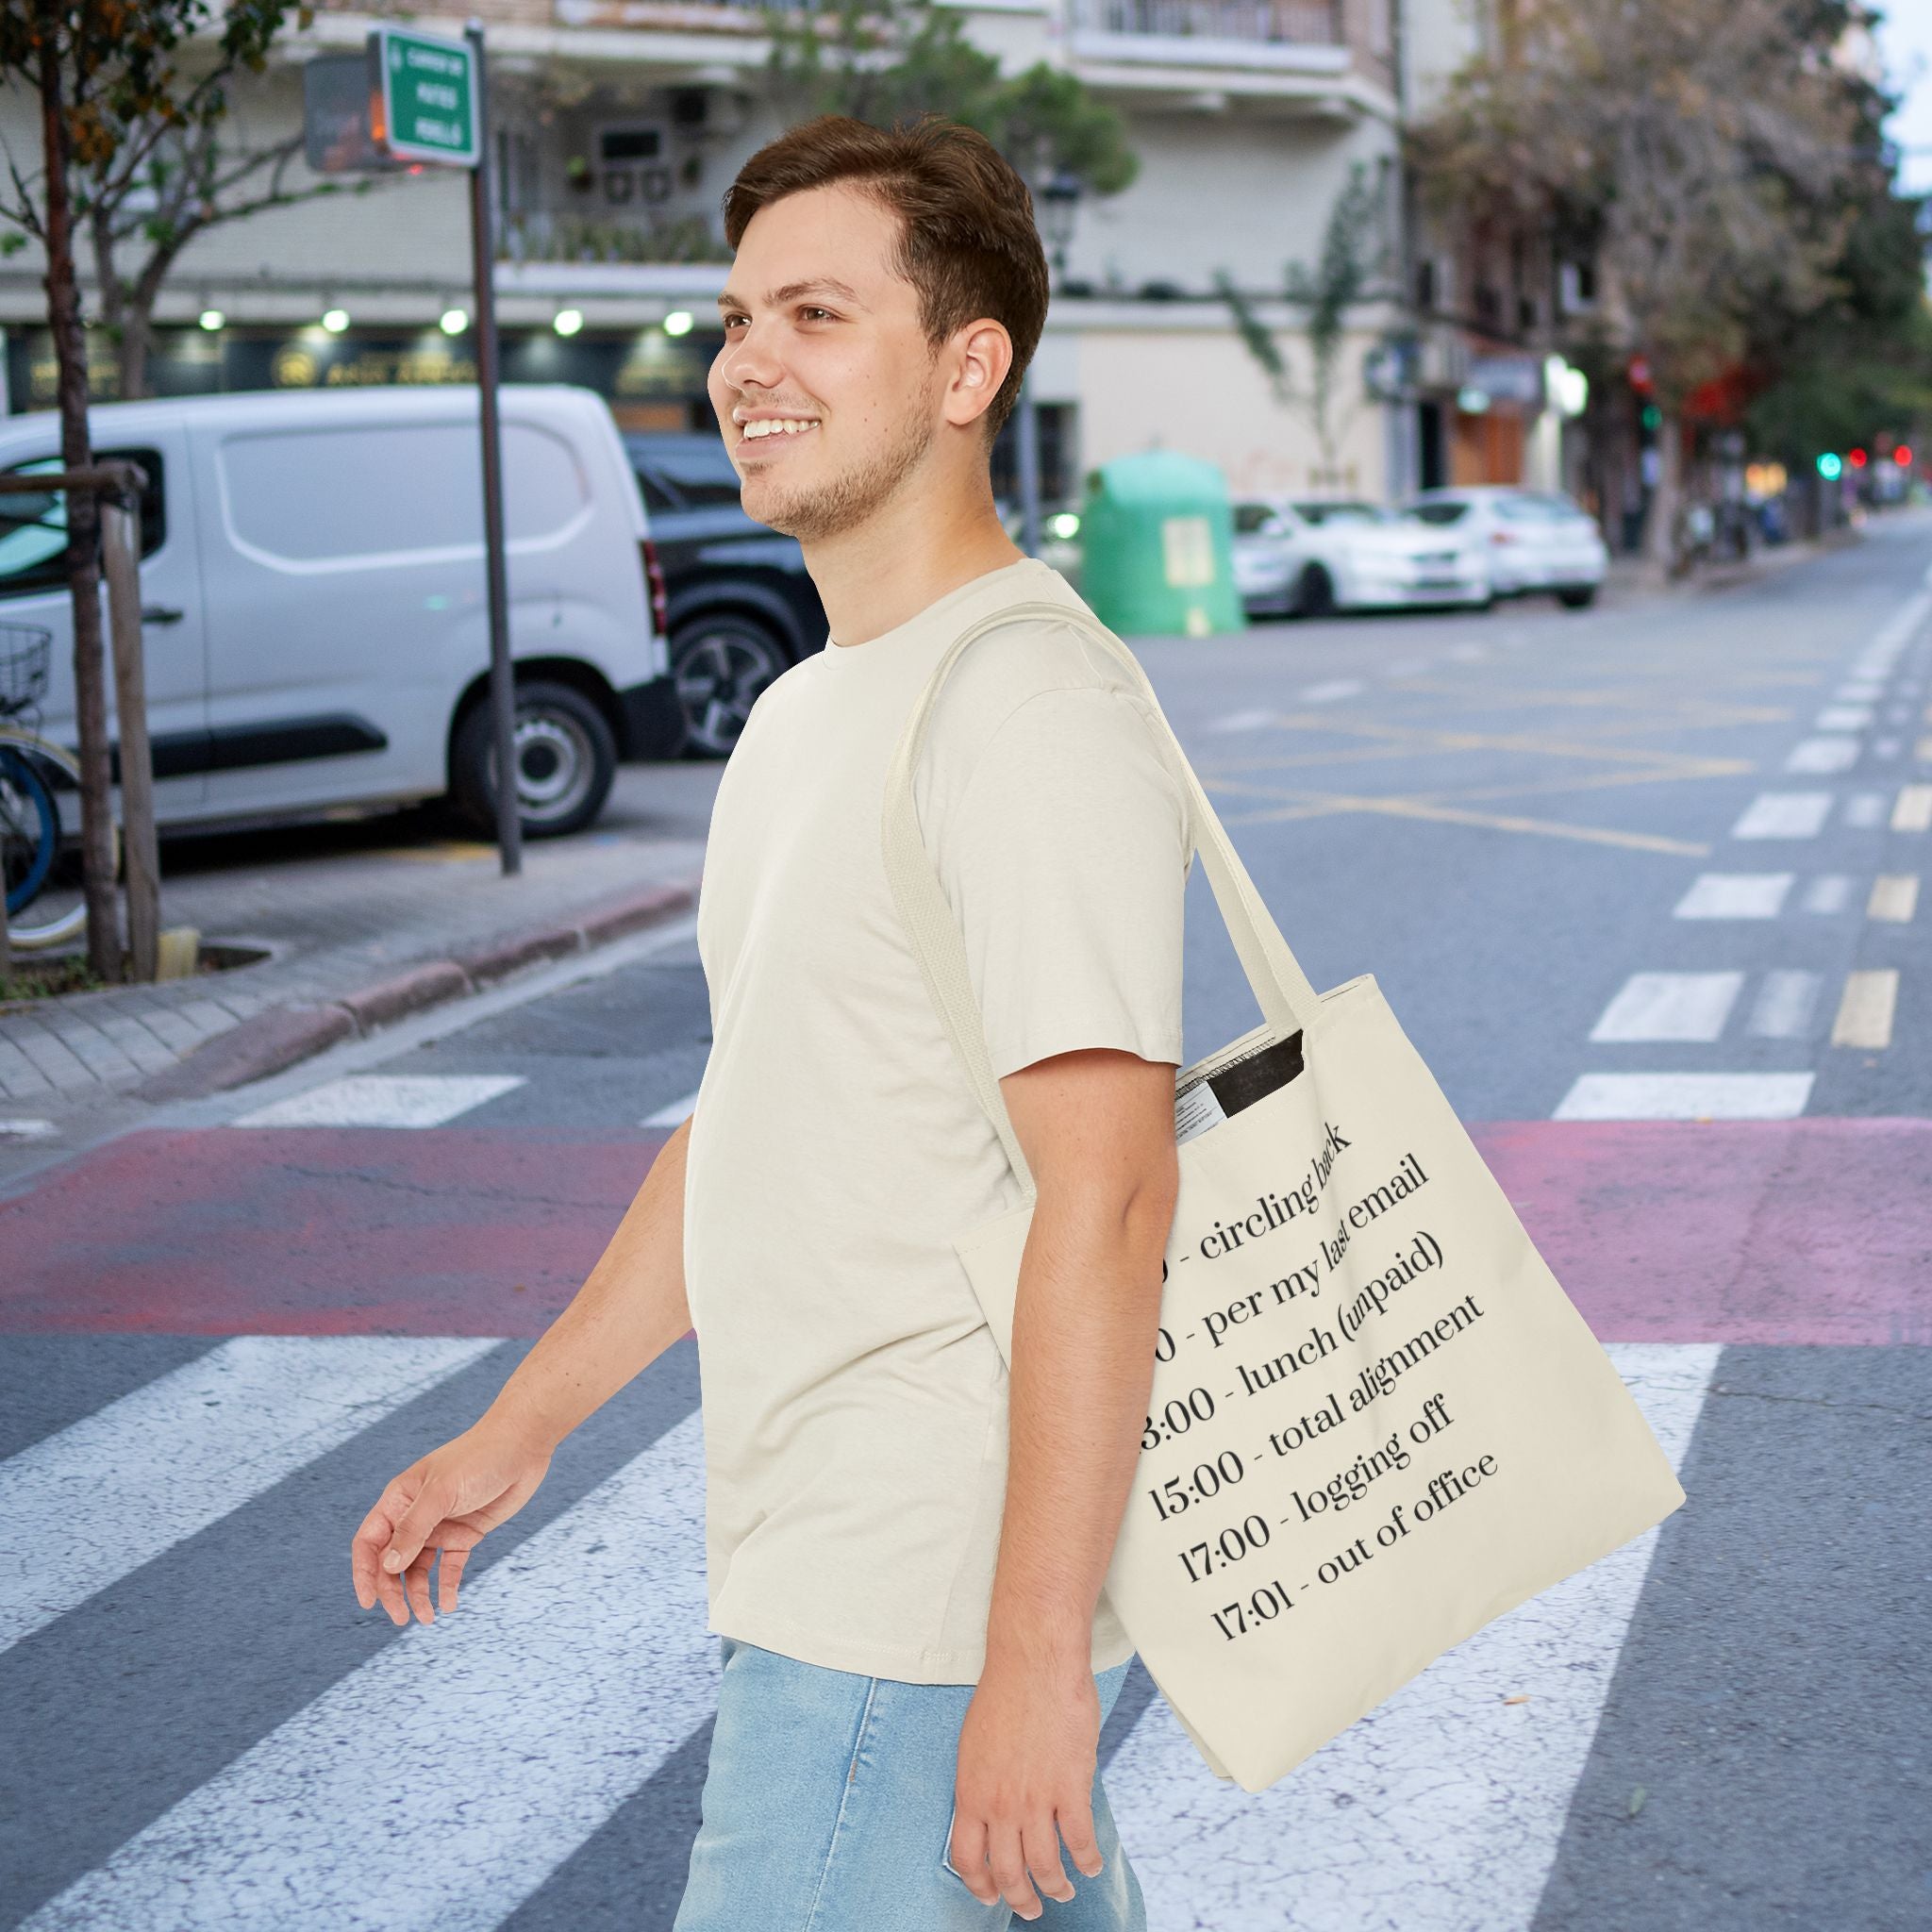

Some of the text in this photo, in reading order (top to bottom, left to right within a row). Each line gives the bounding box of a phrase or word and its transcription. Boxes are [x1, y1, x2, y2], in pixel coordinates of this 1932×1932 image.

[1200, 1174, 1319, 1259] circling
[1311, 1122, 1352, 1191] back
[1202, 1291, 1263, 1349] per
[1270, 1259, 1320, 1305] my
[1320, 1219, 1351, 1273] last
[1348, 1153, 1430, 1228] email
[1139, 1388, 1215, 1454] 3:00
[1236, 1327, 1339, 1396] lunch
[1338, 1231, 1443, 1342] (unpaid)
[1148, 1451, 1244, 1522] 15:00
[1268, 1393, 1347, 1457] total
[1349, 1295, 1485, 1412] alignment
[1177, 1515, 1271, 1583] 17:00
[1291, 1433, 1411, 1523] logging
[1409, 1392, 1455, 1443] off
[1210, 1580, 1294, 1641] 17:01
[1318, 1538, 1374, 1585] out
[1376, 1505, 1410, 1548] of
[1413, 1454, 1498, 1522] office
